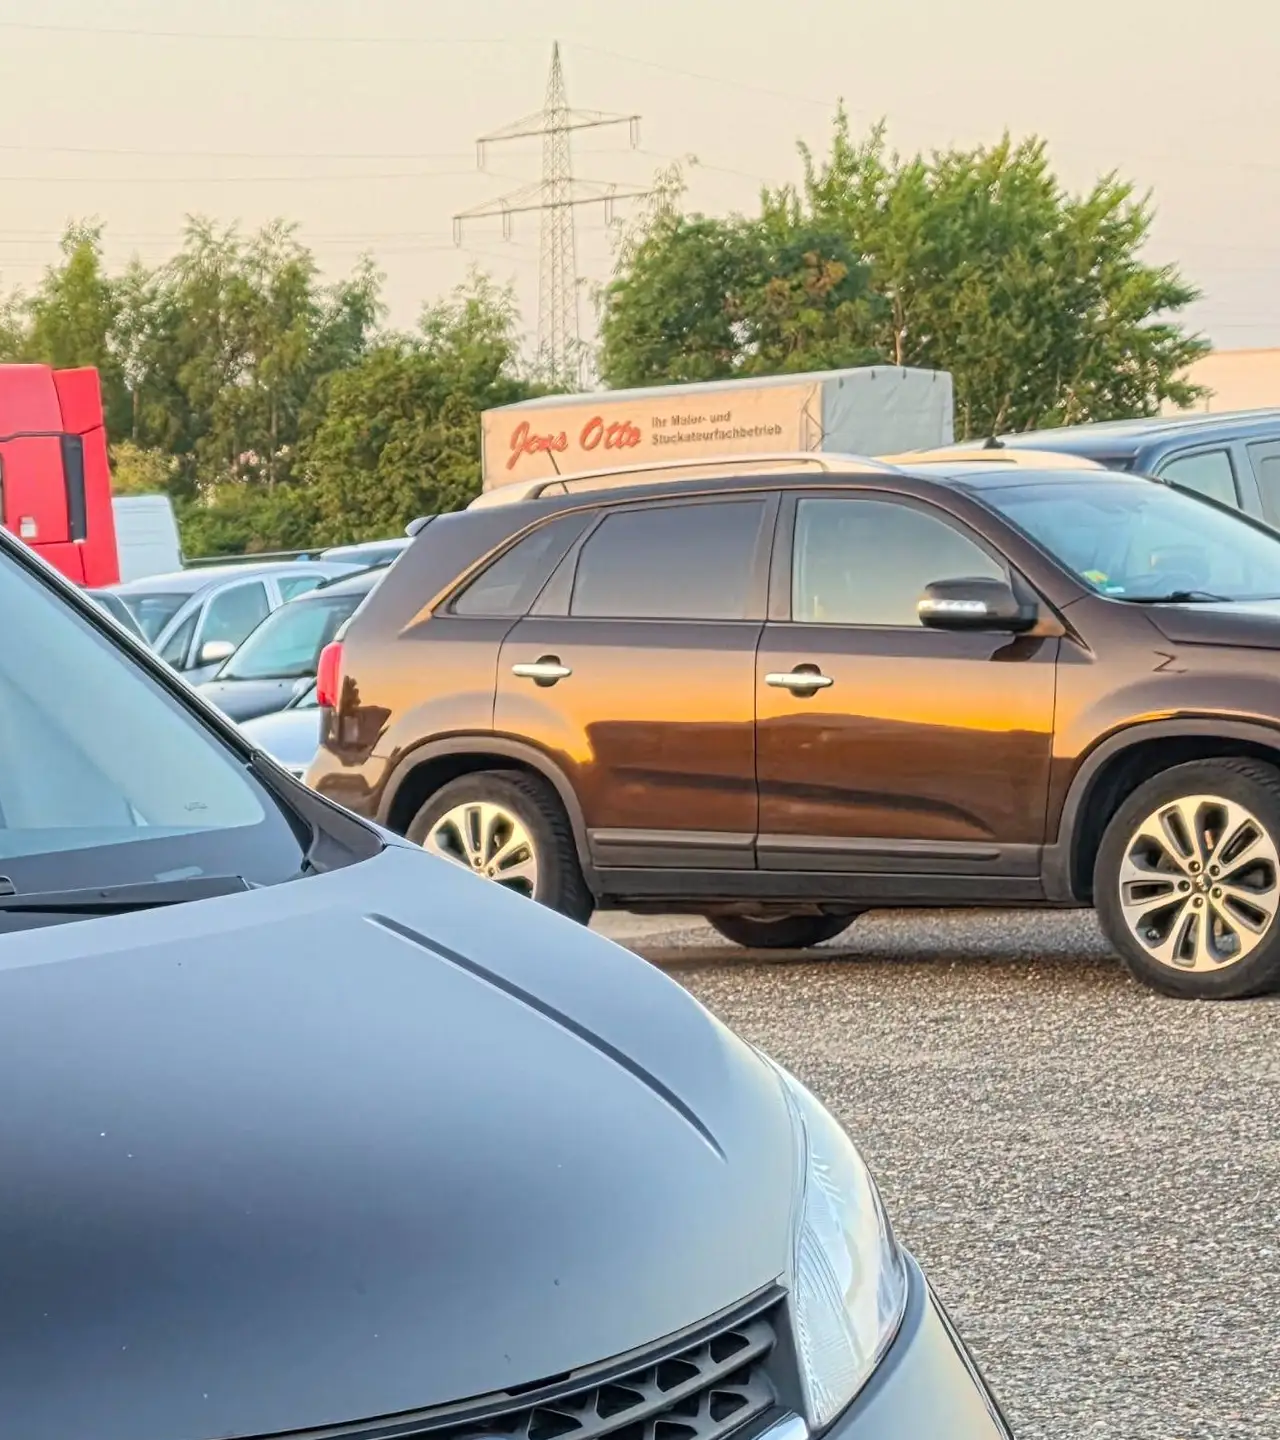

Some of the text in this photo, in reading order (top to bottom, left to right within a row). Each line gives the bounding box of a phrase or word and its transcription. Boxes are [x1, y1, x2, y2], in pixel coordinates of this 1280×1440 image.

[710, 411, 731, 423] und
[506, 416, 642, 470] Jens Otto
